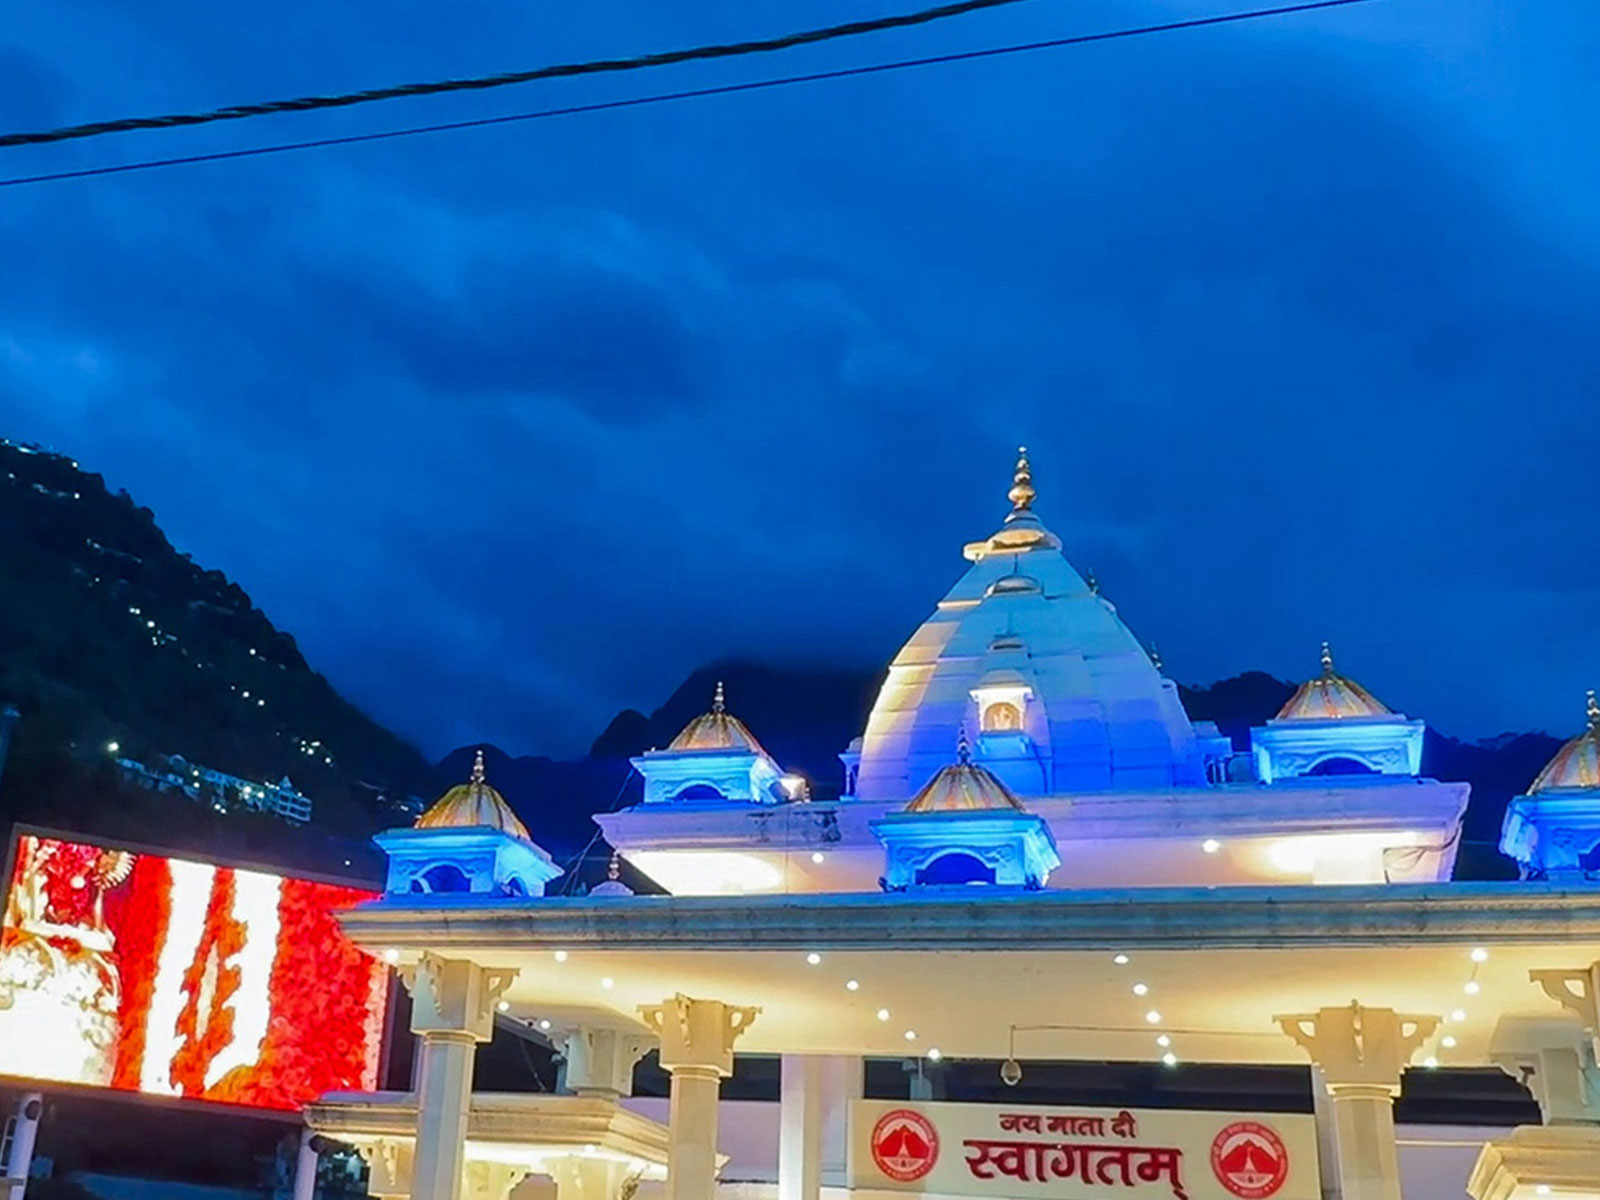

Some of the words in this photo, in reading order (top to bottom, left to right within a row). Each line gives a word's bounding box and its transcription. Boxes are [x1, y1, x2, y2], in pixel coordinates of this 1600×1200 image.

[999, 1114, 1042, 1133] जय
[1047, 1116, 1104, 1137] माता
[1111, 1111, 1136, 1138] दी
[963, 1140, 1189, 1200] स्वागतम्
